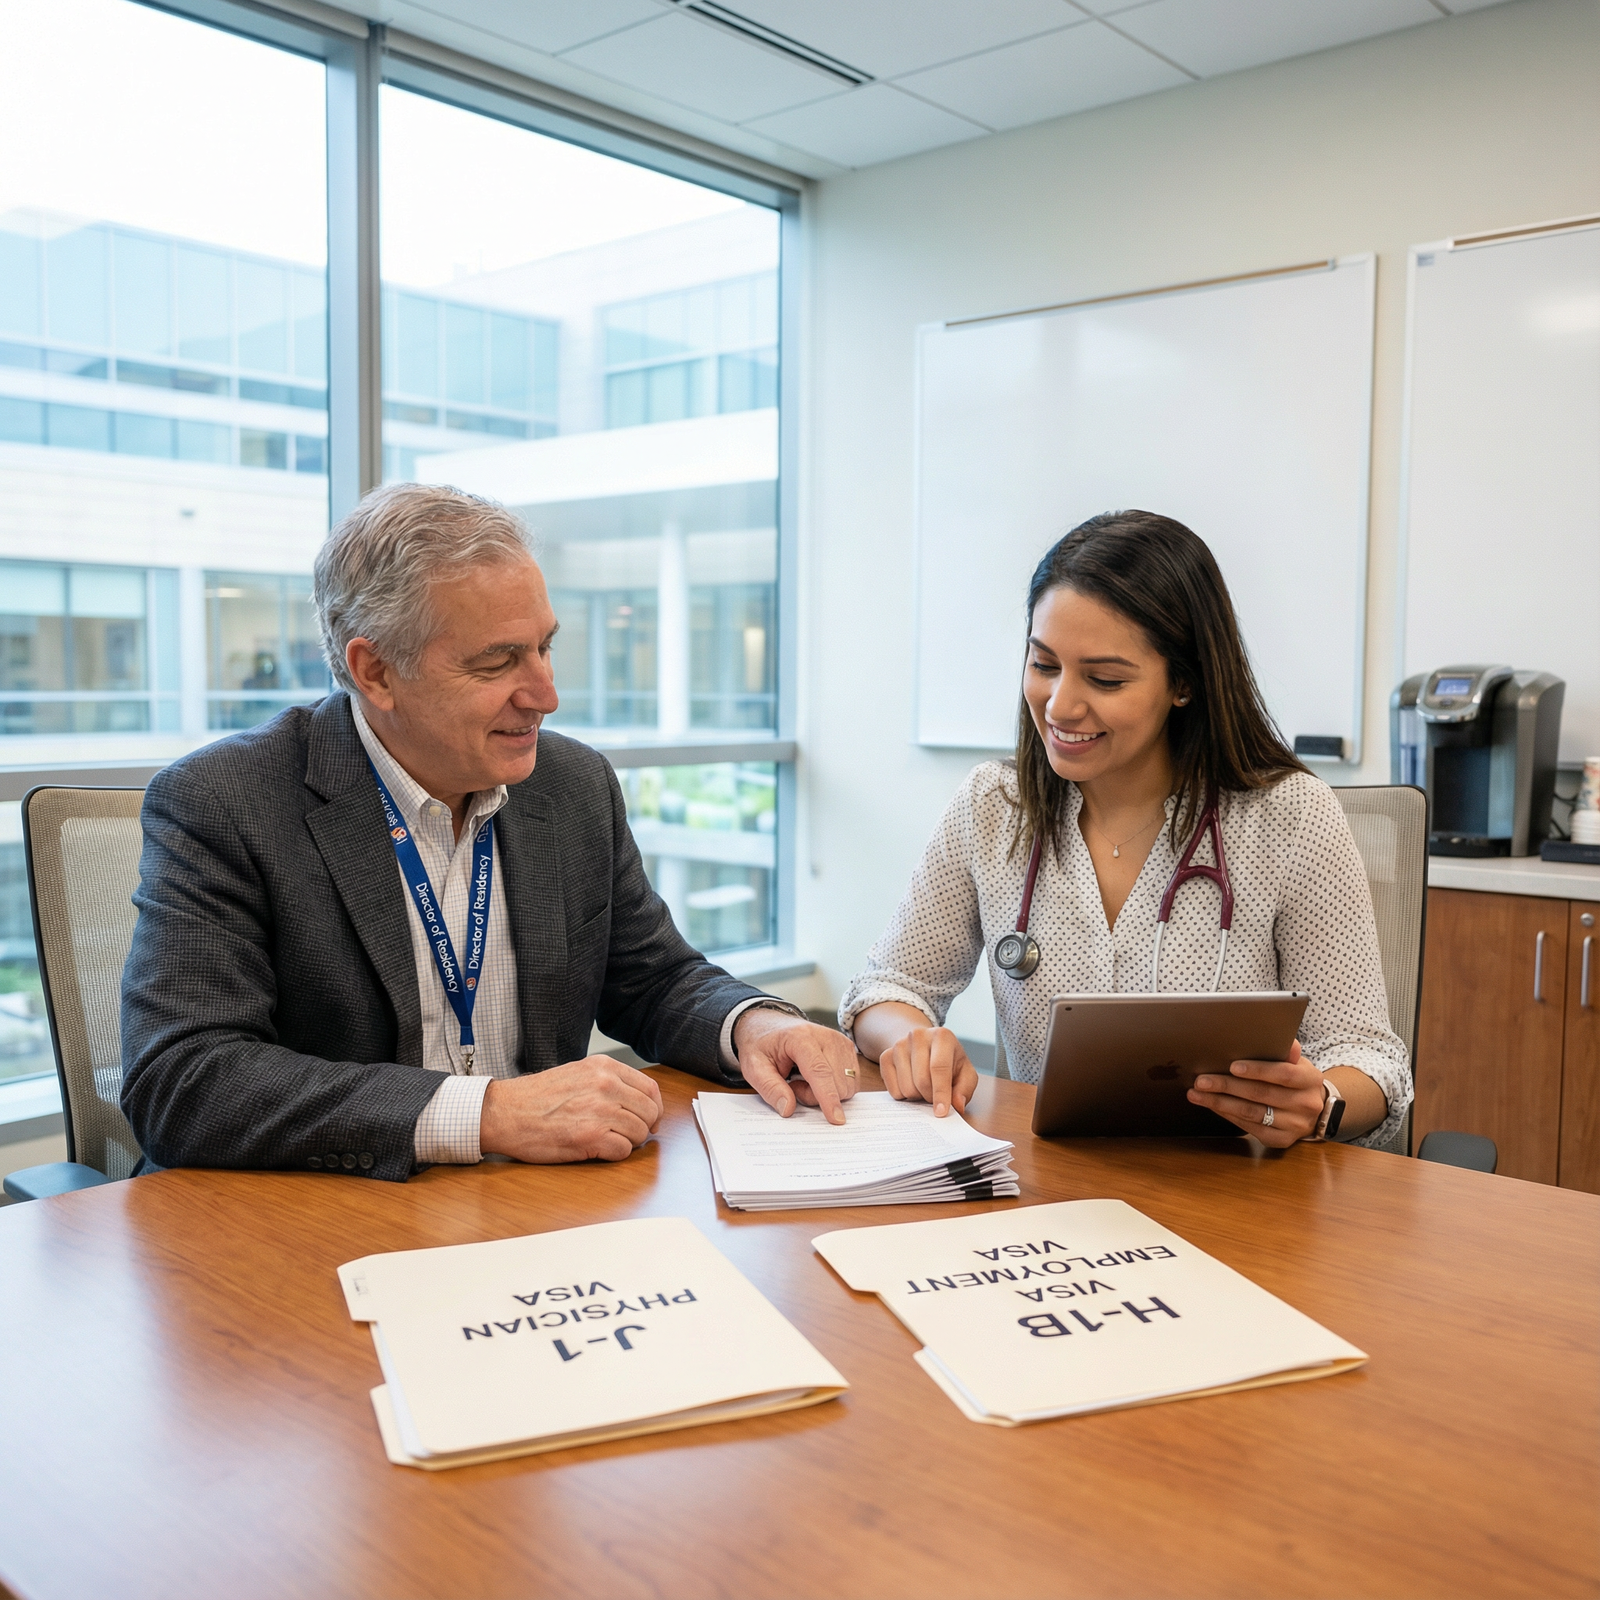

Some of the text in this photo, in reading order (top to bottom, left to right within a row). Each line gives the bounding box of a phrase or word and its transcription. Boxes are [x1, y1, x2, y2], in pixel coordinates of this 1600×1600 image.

[431, 924, 446, 937] of
[472, 911, 485, 926] of
[972, 1239, 1069, 1262] VISA
[906, 1244, 1179, 1295] EMPLOYMENT
[512, 1280, 616, 1308] VISA
[1015, 1278, 1117, 1303] VISA
[461, 1286, 699, 1342] PHYSICIAN
[1017, 1296, 1182, 1339] H-1B
[551, 1324, 647, 1363] J-1
